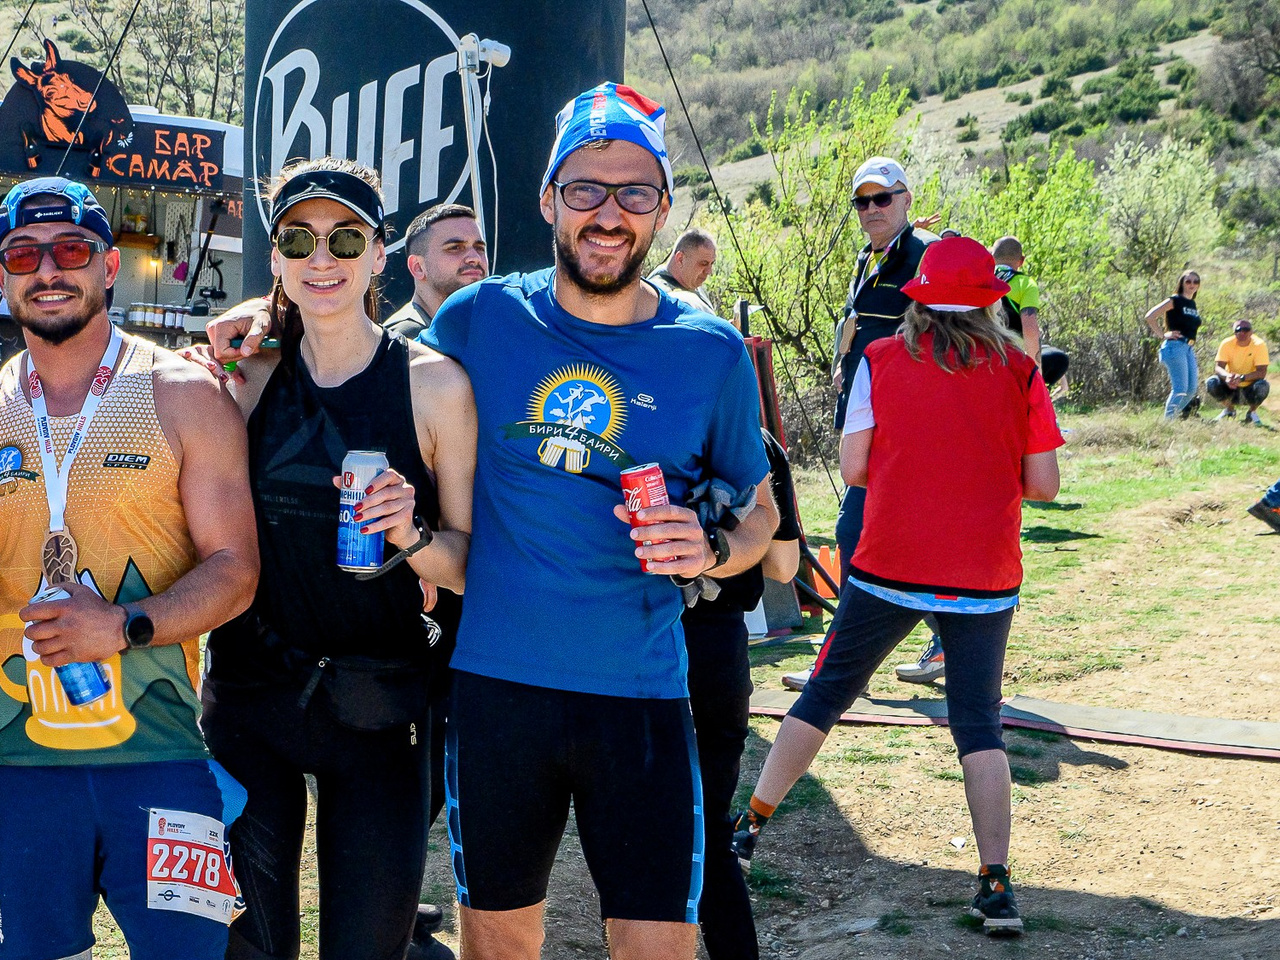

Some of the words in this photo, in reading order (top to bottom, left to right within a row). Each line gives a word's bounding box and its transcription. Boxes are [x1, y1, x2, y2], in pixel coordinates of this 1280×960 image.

[155, 129, 212, 159] БАР
[265, 49, 457, 215] BUFF
[106, 154, 219, 187] САМАР
[107, 454, 148, 464] DIEM
[529, 425, 562, 437] БИРИ
[565, 426, 580, 439] 4
[579, 434, 620, 461] БАИРИ
[151, 843, 221, 888] 2278
